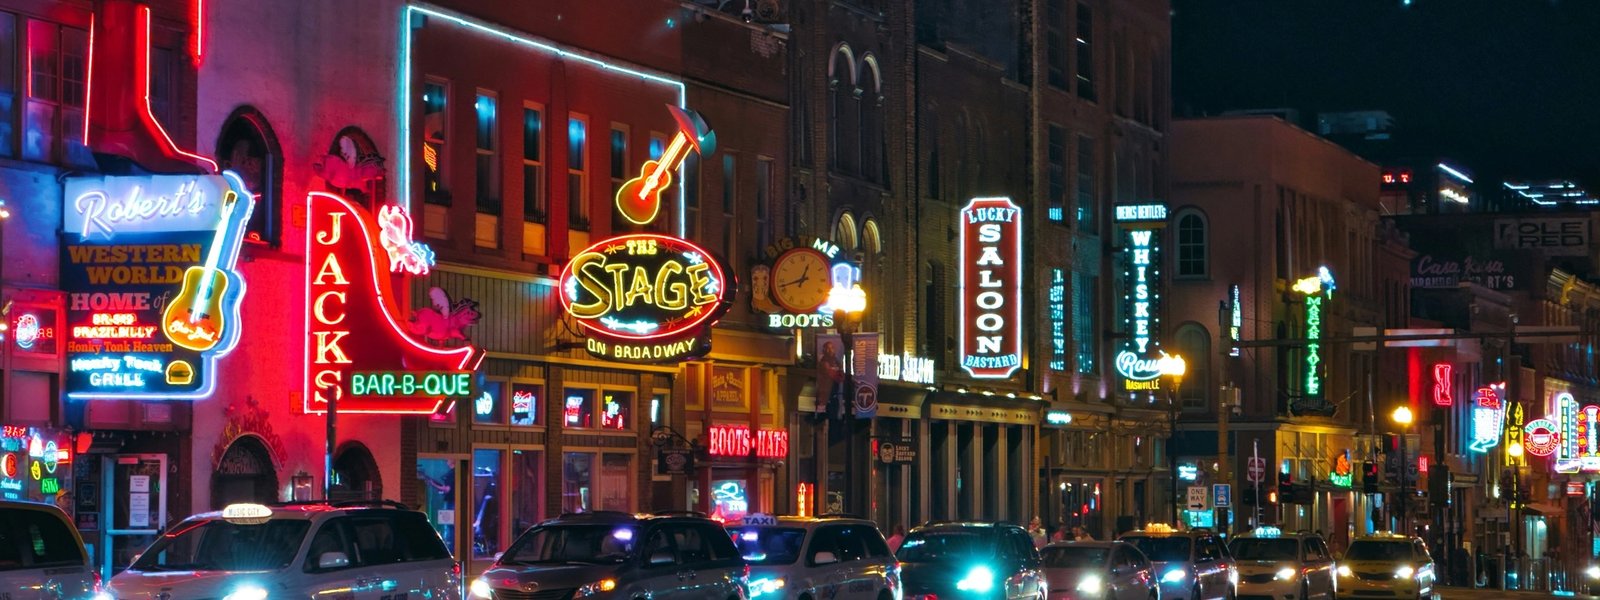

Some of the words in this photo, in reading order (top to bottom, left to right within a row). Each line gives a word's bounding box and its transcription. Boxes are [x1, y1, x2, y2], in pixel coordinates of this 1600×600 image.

[75, 180, 206, 240] Robert's
[967, 207, 1015, 224] LUCKY
[1518, 221, 1584, 235] OLE
[626, 240, 657, 255] THE
[1518, 235, 1584, 247] RED
[68, 244, 202, 264] WESTERN
[1417, 255, 1460, 275] Casa
[86, 266, 184, 285] WORLD
[569, 251, 718, 319] STAGE
[976, 224, 1004, 354] SALOON
[1131, 230, 1152, 353] WHISKEY
[70, 293, 150, 311] HOME
[153, 291, 169, 315] of
[313, 211, 352, 403] JACKS
[769, 313, 834, 328] BOOTS
[73, 326, 156, 338] BRAZILBILLY
[67, 341, 102, 355] Honky
[104, 341, 131, 353] Tonk
[132, 341, 173, 353] Heaven
[587, 338, 606, 355] ON
[614, 338, 696, 359] BROADWAY
[967, 355, 1017, 369] BASTARD
[89, 372, 145, 387] GRILL
[352, 374, 470, 396] BAR-B-QUE
[1126, 379, 1160, 391] NASHVILLE
[1478, 388, 1496, 398] Tin
[709, 427, 750, 456] BOOTS
[756, 430, 788, 457] HATS
[42, 478, 58, 493] ATM
[744, 517, 774, 525] TAXI
